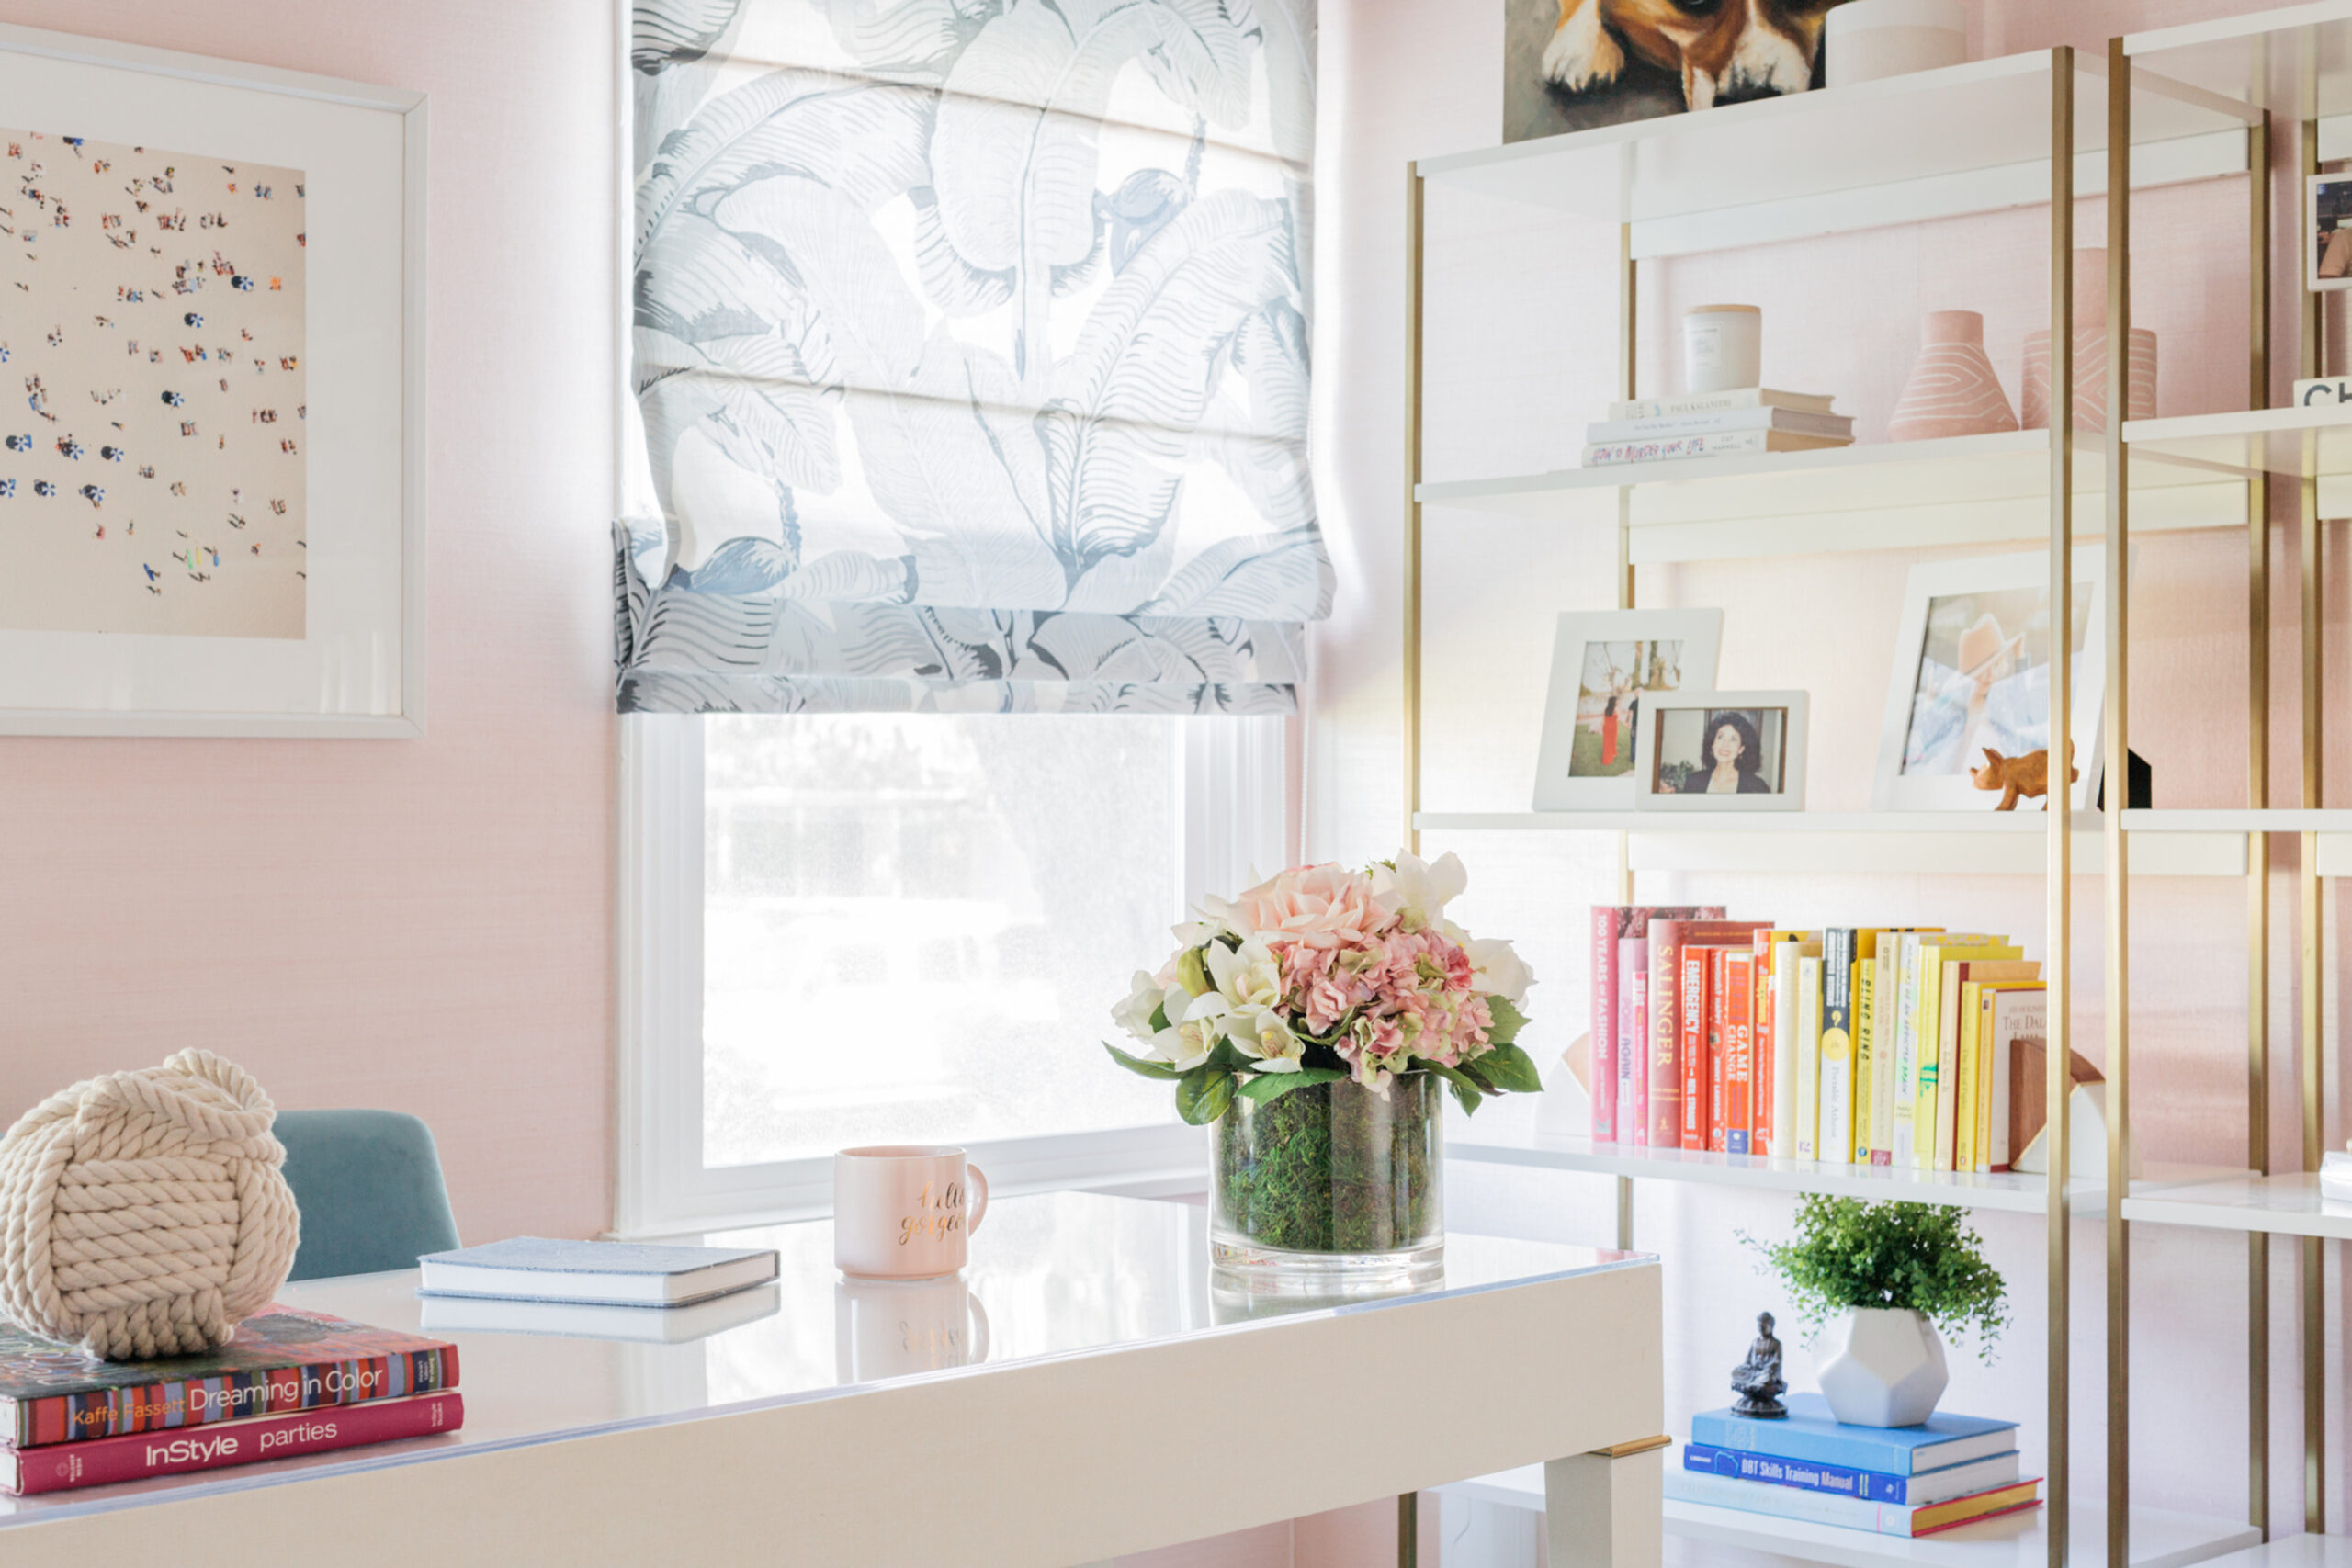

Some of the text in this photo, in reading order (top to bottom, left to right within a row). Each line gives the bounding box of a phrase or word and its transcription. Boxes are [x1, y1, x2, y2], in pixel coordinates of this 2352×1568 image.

[1597, 913, 1608, 937] 100
[1597, 938, 1608, 982] YEARS
[1657, 945, 1673, 1067] SALINGER
[1685, 960, 1701, 1034] EMERGENCY
[1860, 978, 1871, 1021] BLING
[1597, 998, 1608, 1060] FASHION
[1860, 1028, 1871, 1061] RING
[1620, 1037, 1632, 1079] AGAIN
[1726, 1024, 1737, 1081] CHANGE
[1736, 1024, 1748, 1082] GAME
[73, 1369, 383, 1427] Kaffe Fassett Dreaming in Color
[146, 1422, 339, 1467] InStyle parties
[1741, 1458, 1759, 1476] DBT
[1759, 1461, 1783, 1480] Skills
[1785, 1464, 1819, 1487] Training
[1821, 1471, 1853, 1492] Manual
